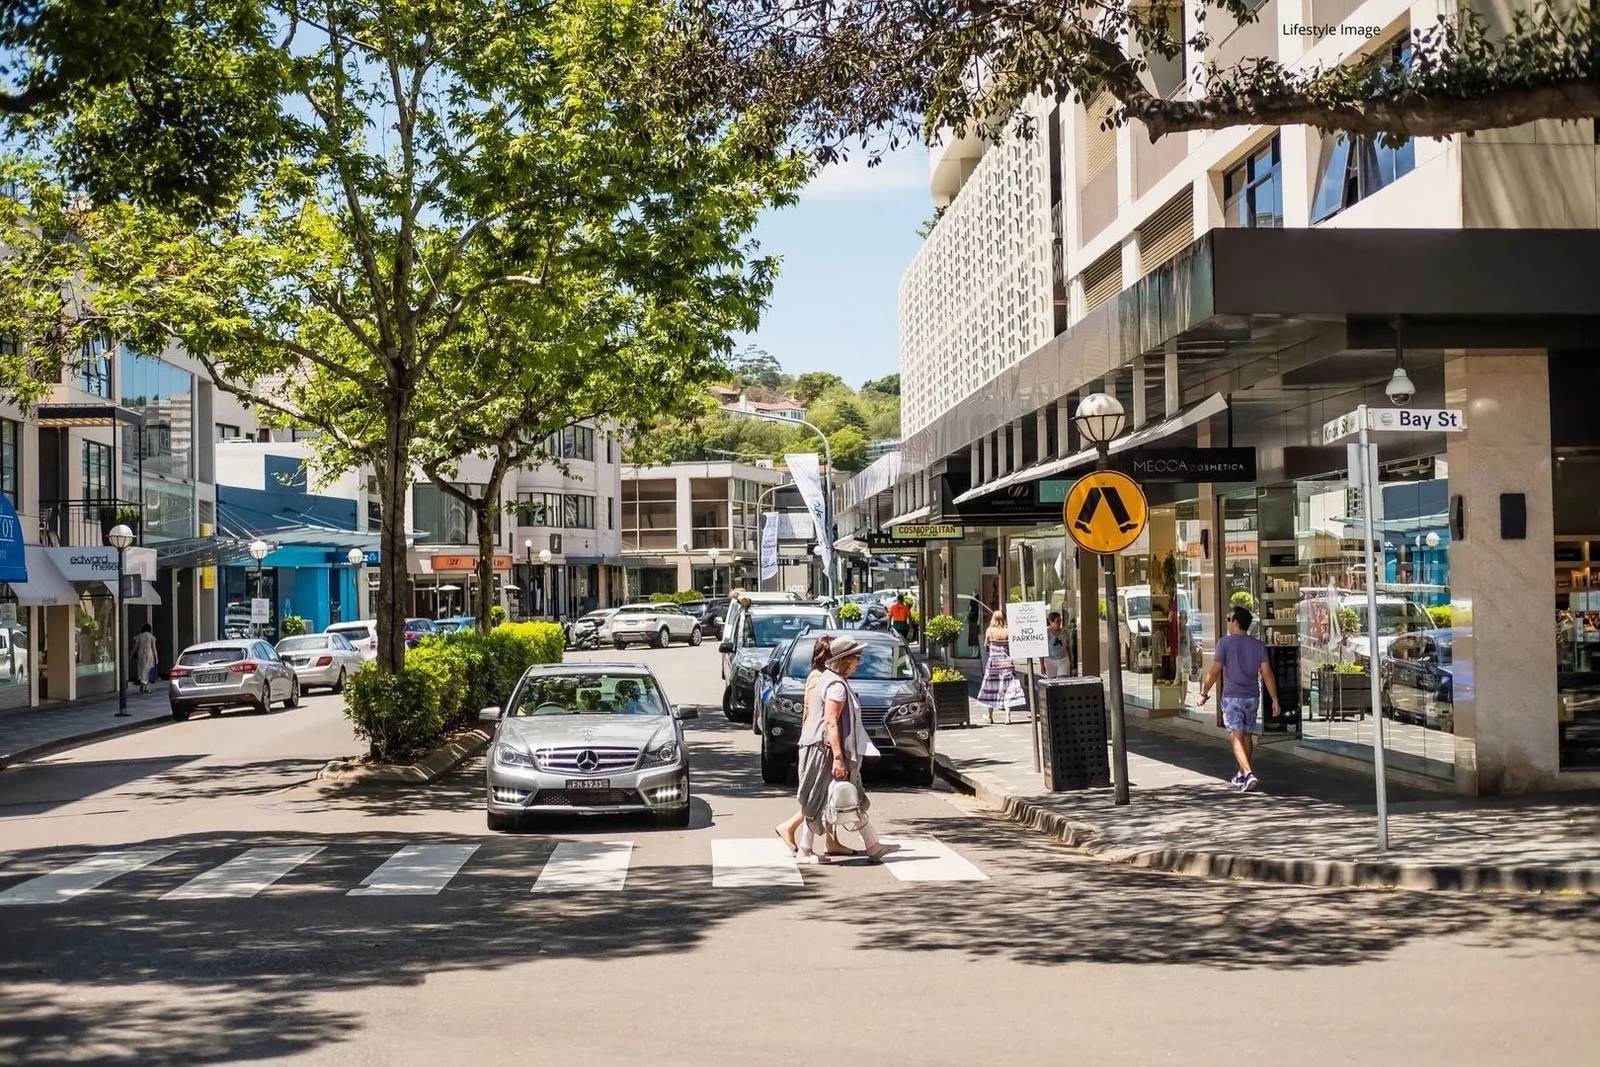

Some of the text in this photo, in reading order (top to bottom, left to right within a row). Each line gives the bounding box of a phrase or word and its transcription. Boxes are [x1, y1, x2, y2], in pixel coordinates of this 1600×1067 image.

[1400, 411, 1457, 430] Bay St
[1133, 460, 1244, 472] MECCA COSMETICA
[899, 526, 956, 534] COSMOPOLITAN
[70, 554, 108, 564] edward
[1021, 627, 1034, 635] NO
[1012, 634, 1045, 642] PARKING
